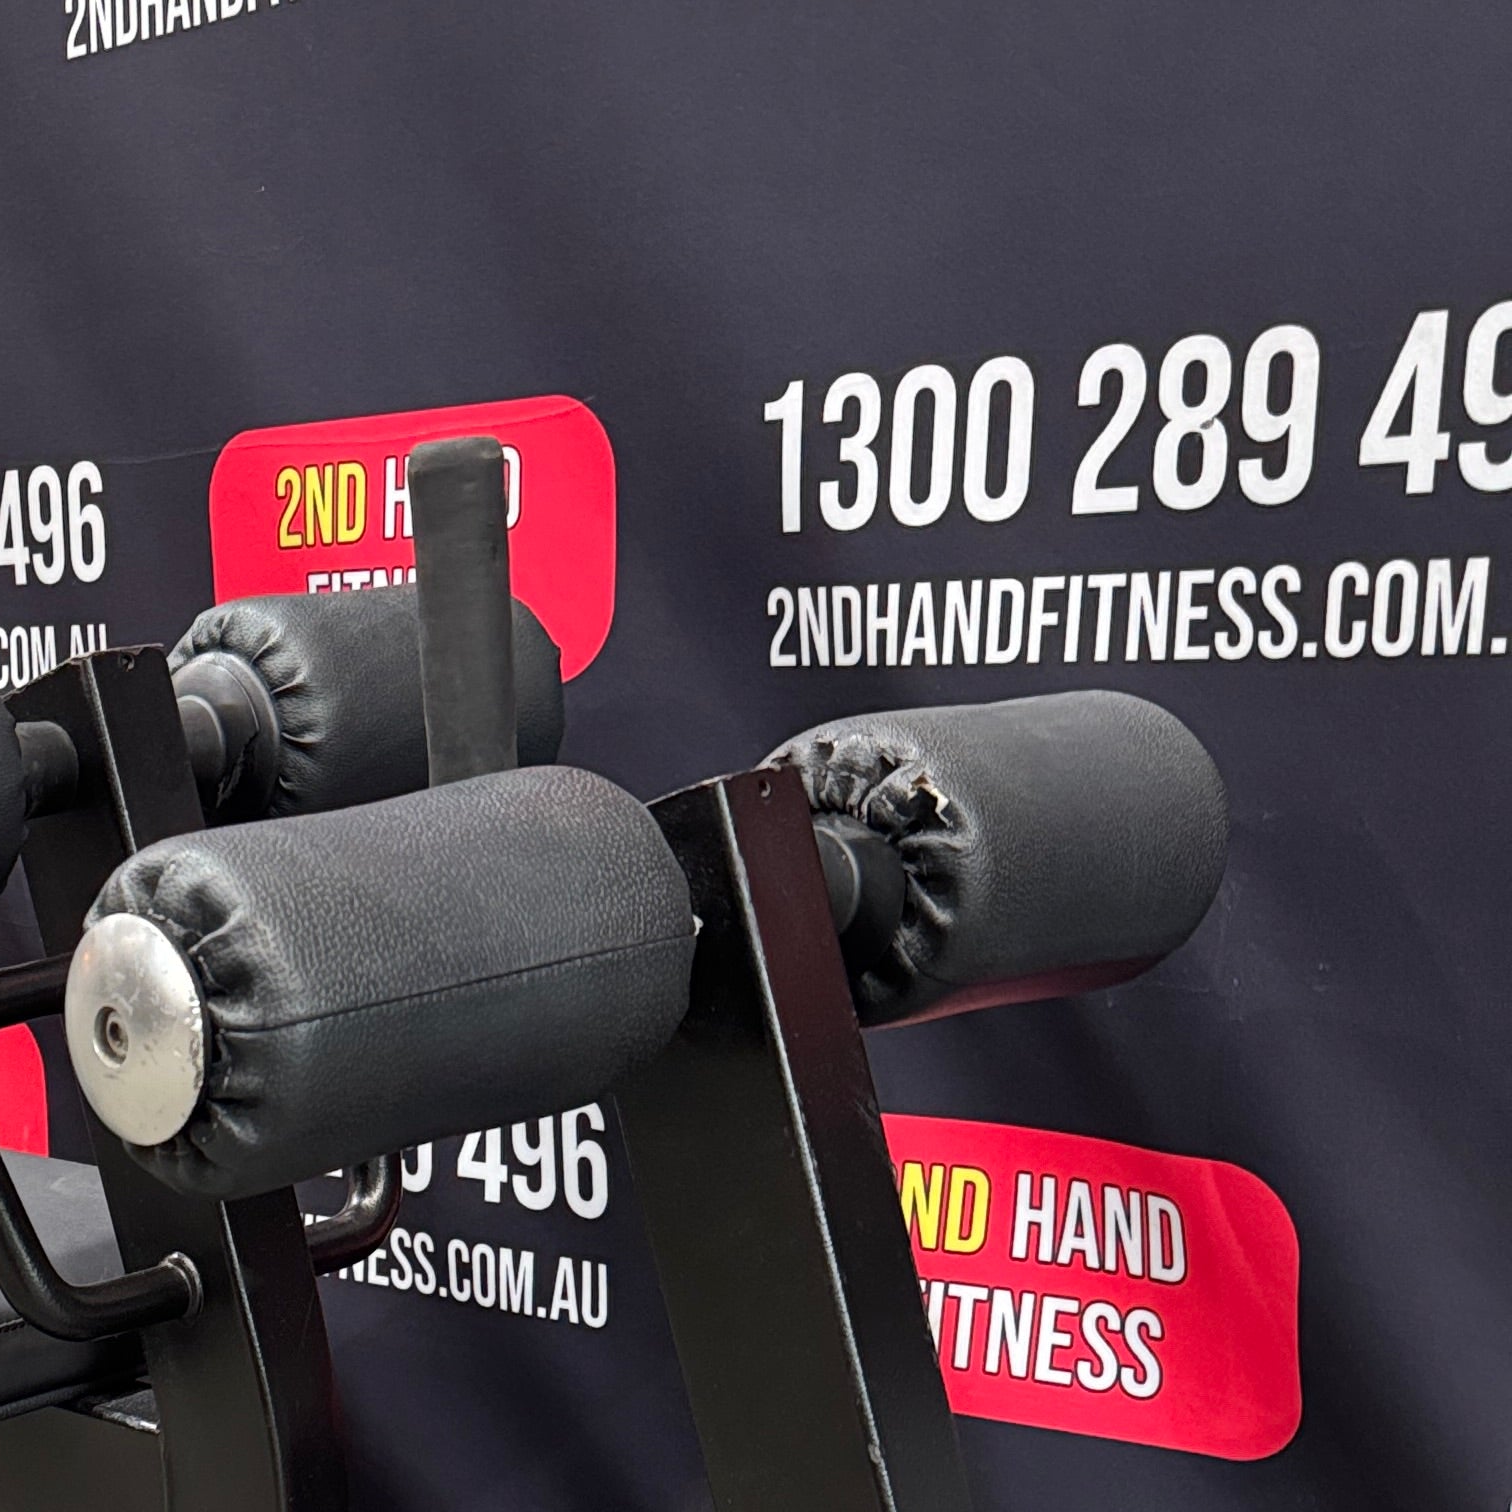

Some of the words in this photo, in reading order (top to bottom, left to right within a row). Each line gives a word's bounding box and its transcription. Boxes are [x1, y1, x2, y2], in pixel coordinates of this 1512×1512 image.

[764, 356, 1034, 532] 1300
[1072, 325, 1320, 514] 289
[278, 463, 365, 546] 2ND
[384, 446, 521, 539] HD
[457, 1103, 608, 1219] 496
[901, 1163, 988, 1252] ND
[1013, 1174, 1184, 1281] HAND
[915, 1280, 1161, 1397] ITNESS
